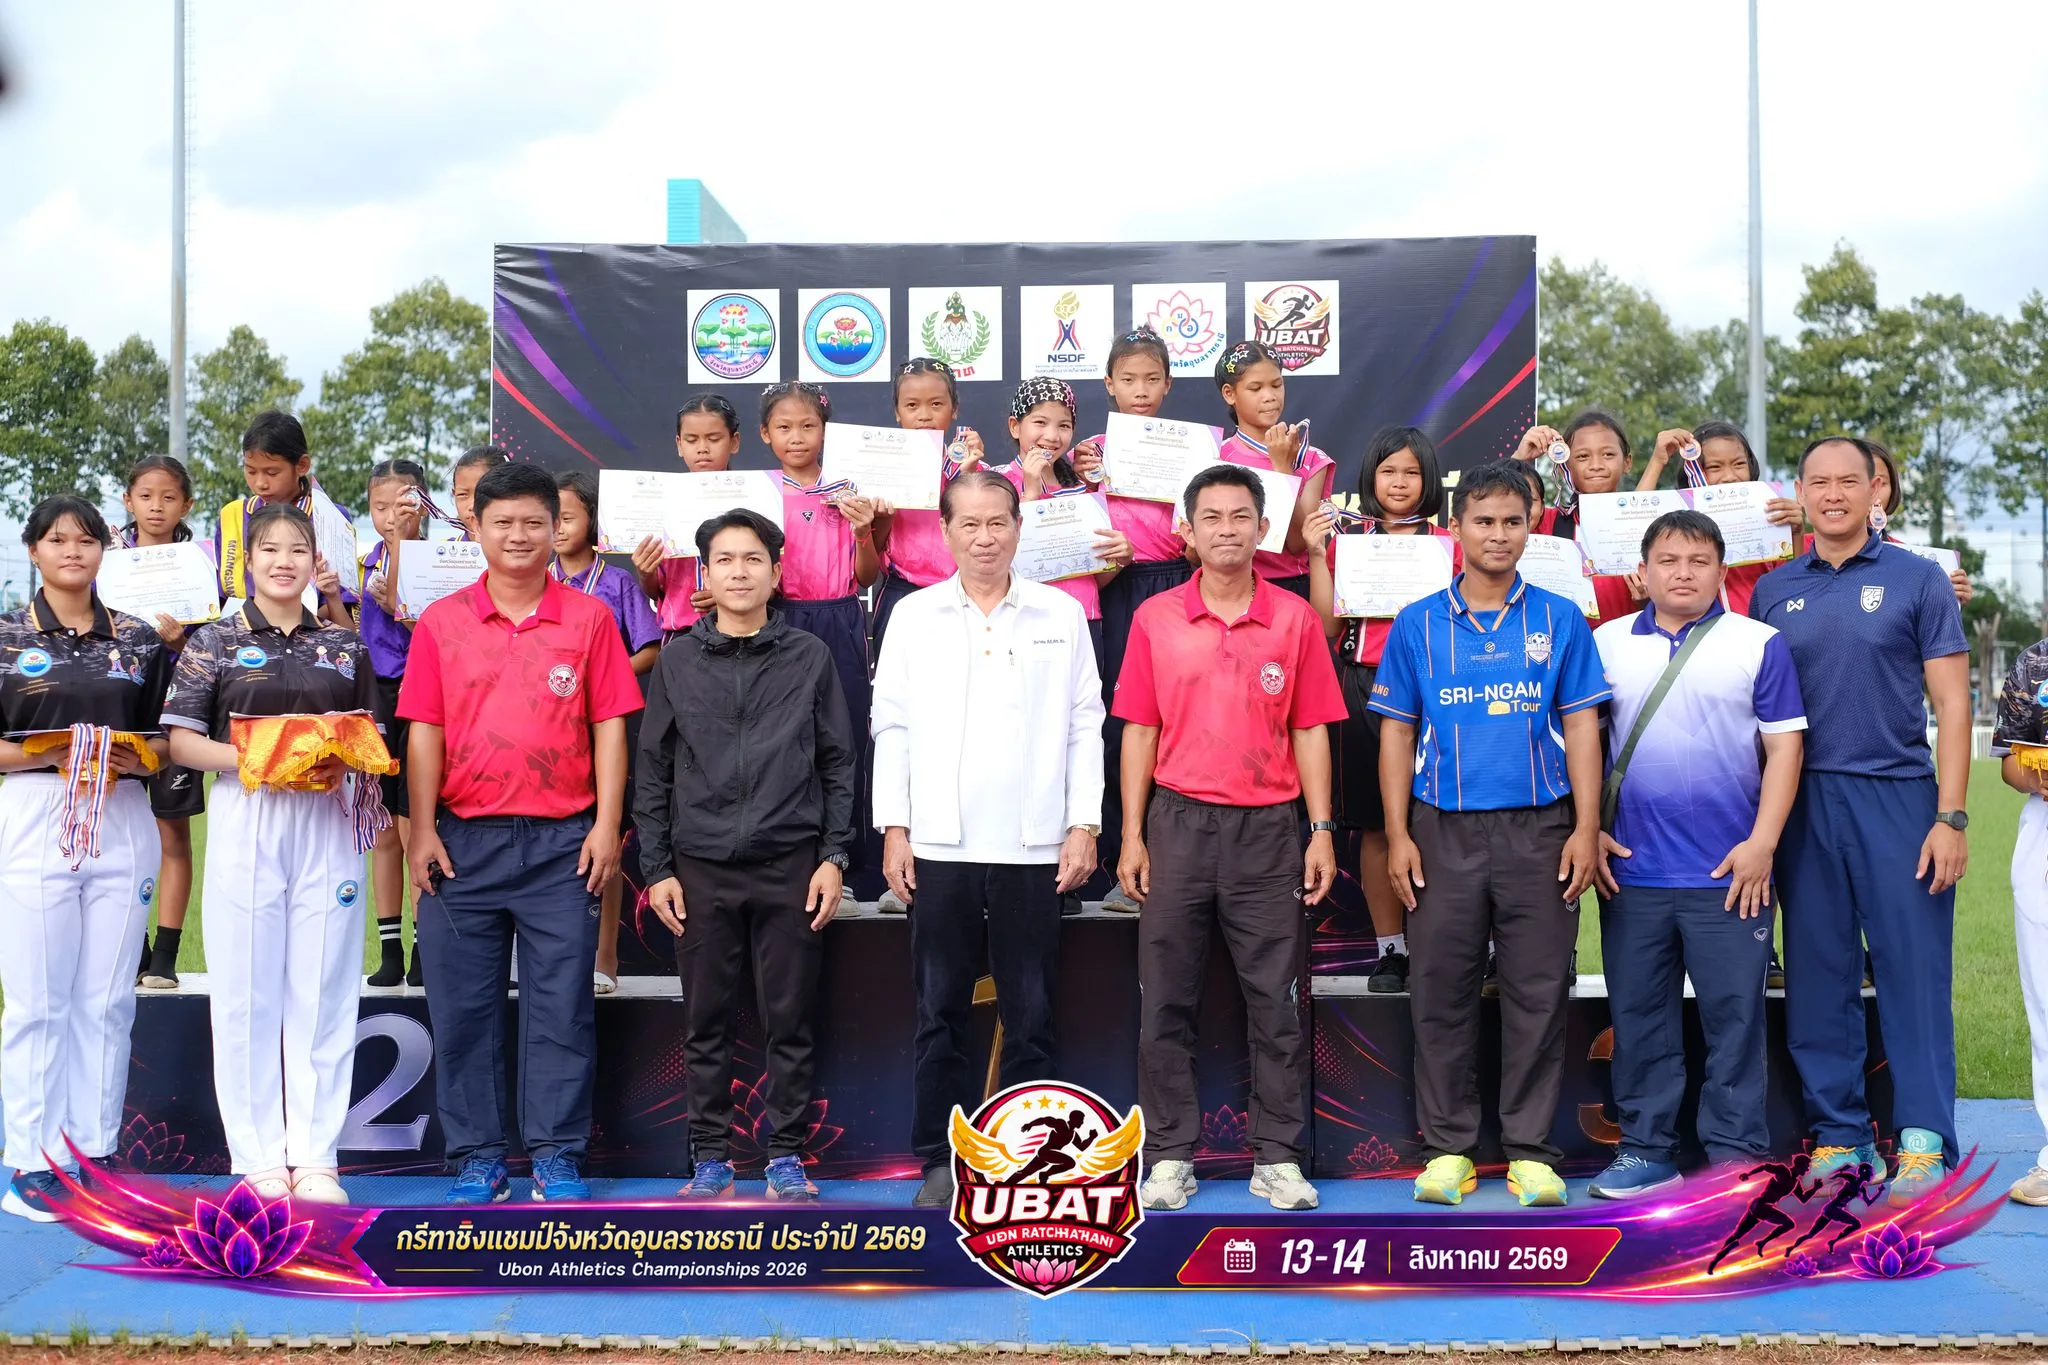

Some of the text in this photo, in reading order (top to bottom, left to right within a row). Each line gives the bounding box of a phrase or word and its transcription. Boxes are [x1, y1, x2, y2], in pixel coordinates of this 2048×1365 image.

[1260, 329, 1324, 345] UBAT
[1047, 354, 1086, 363] NSDF
[1439, 681, 1542, 706] SRI-NGAM
[1510, 699, 1542, 713] Tour
[338, 1012, 435, 1152] 2
